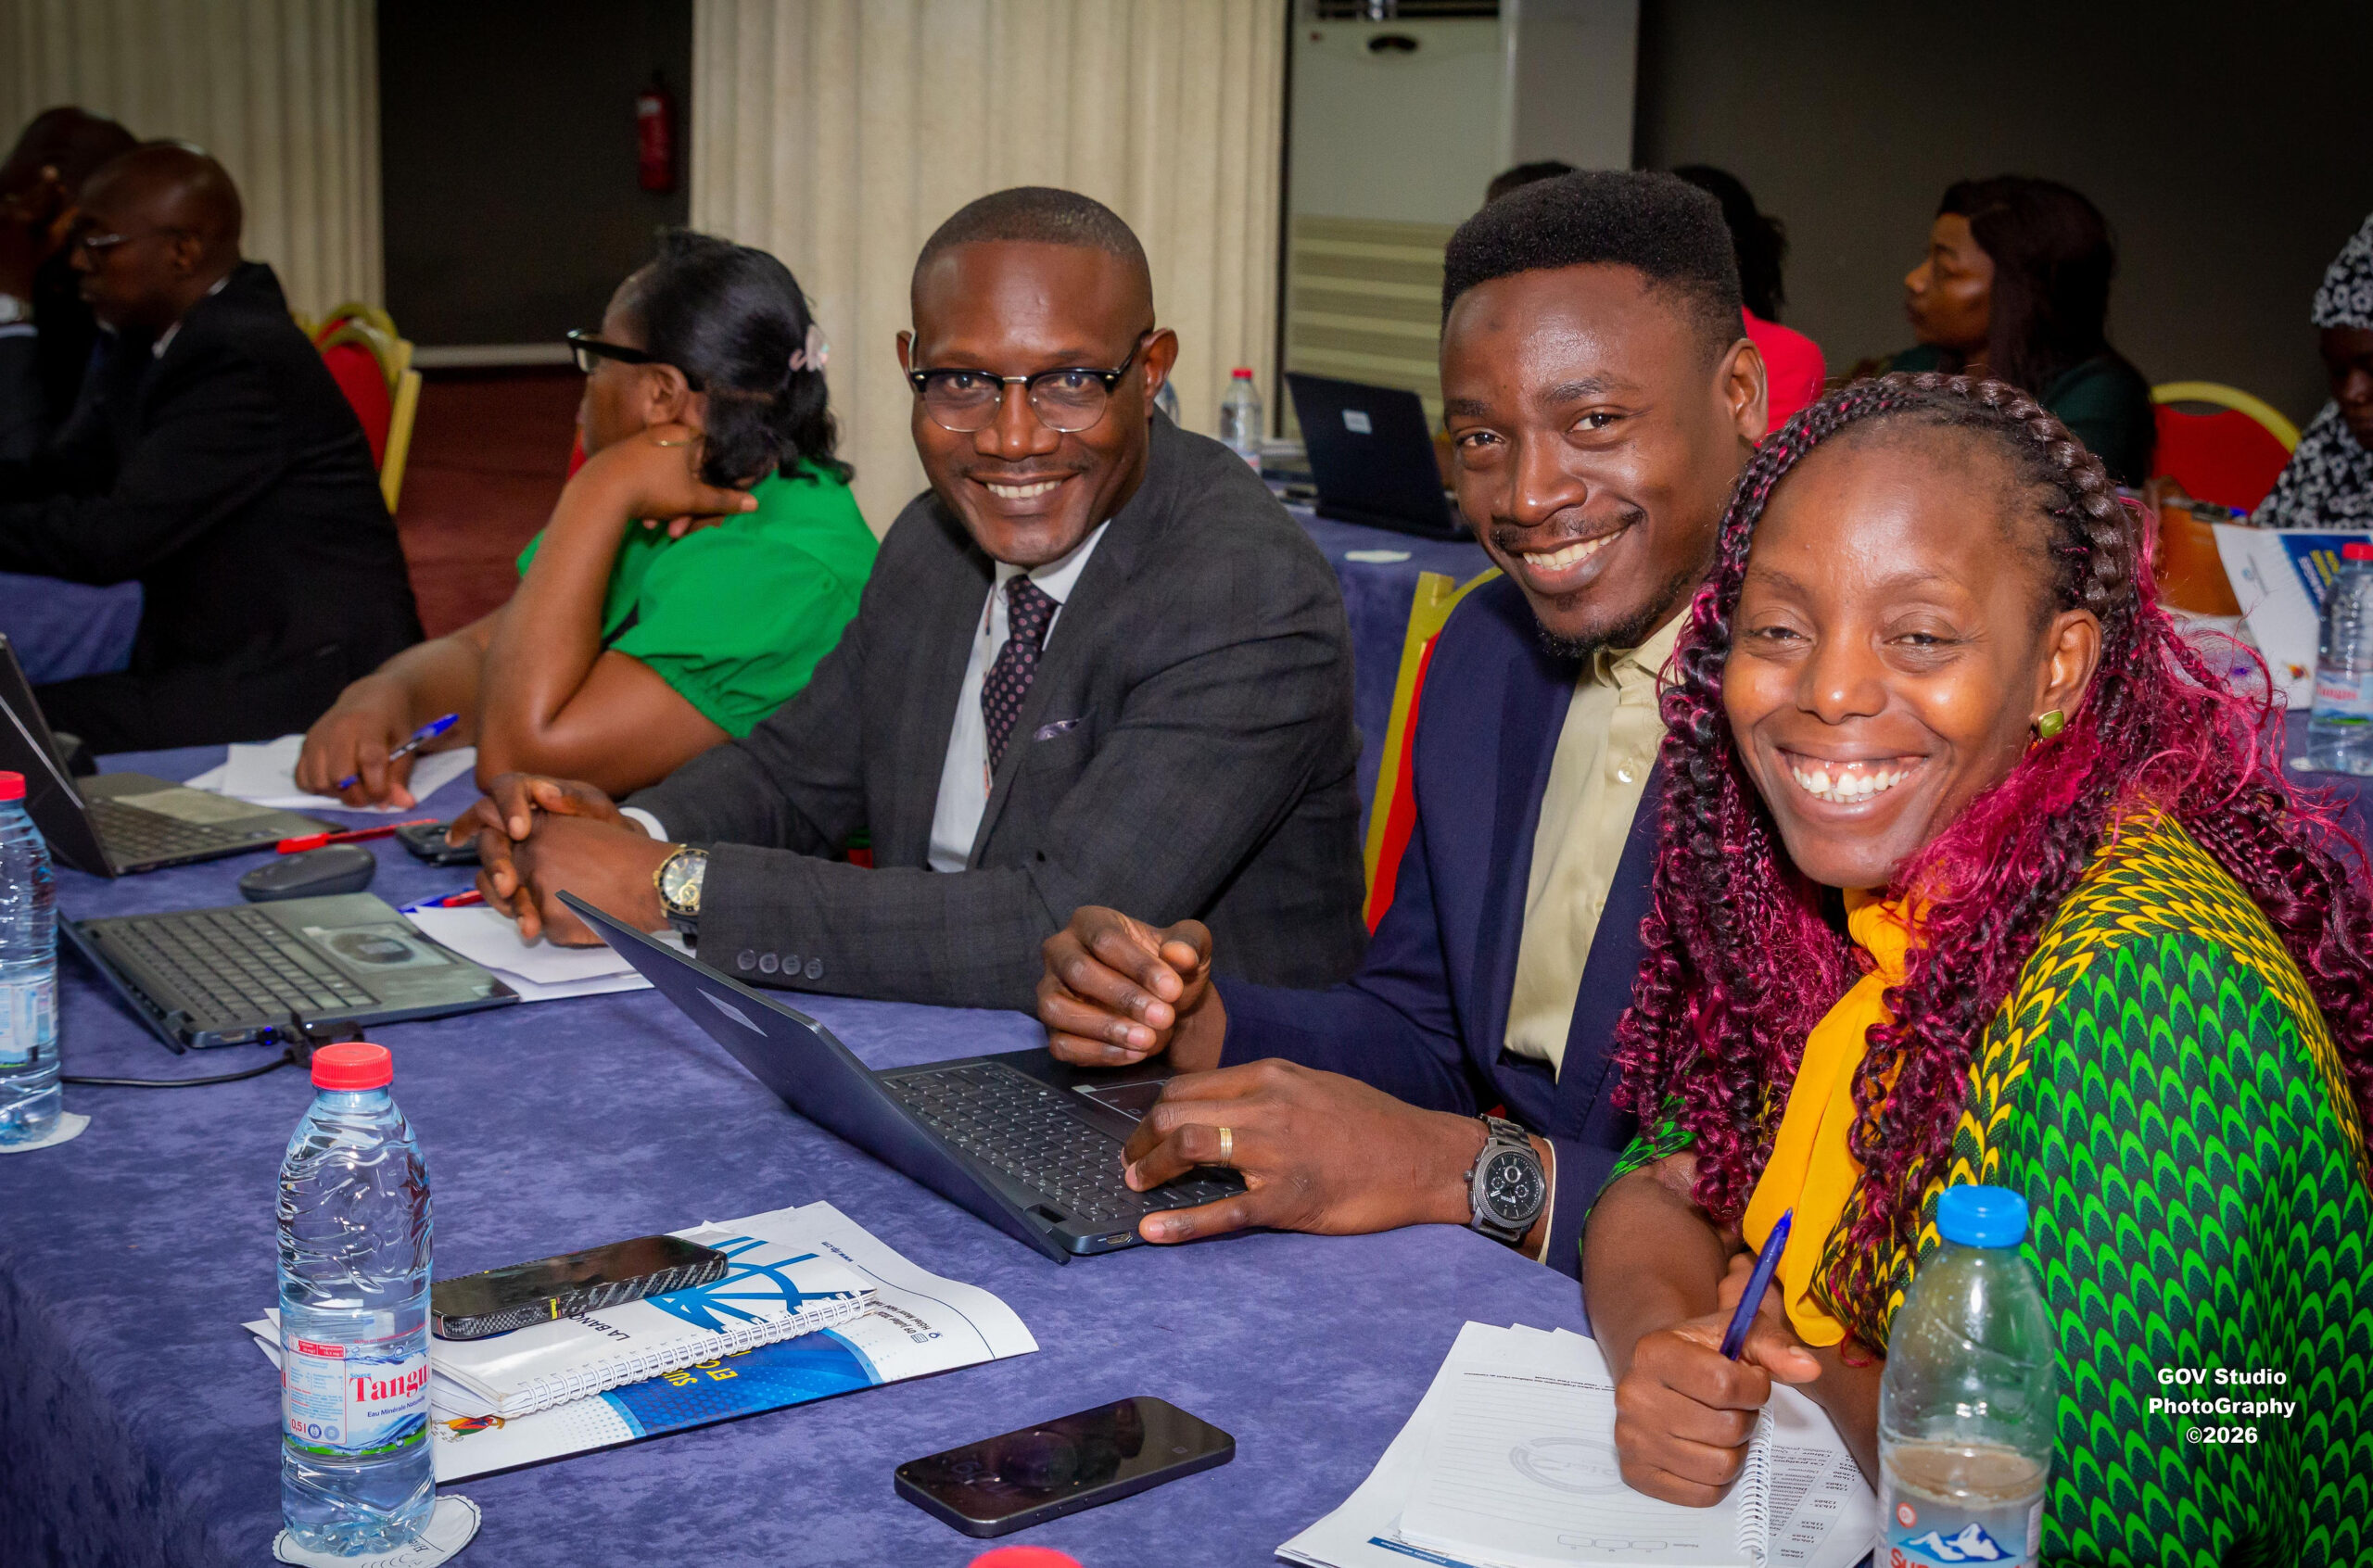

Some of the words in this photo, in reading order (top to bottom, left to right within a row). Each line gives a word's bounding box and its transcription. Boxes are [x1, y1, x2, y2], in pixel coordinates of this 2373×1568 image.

[569, 1311, 612, 1332] BANQ
[607, 1329, 630, 1342] LA
[705, 1367, 739, 1382] ET
[367, 1410, 381, 1418] Eau
[381, 1403, 406, 1415] Minérale
